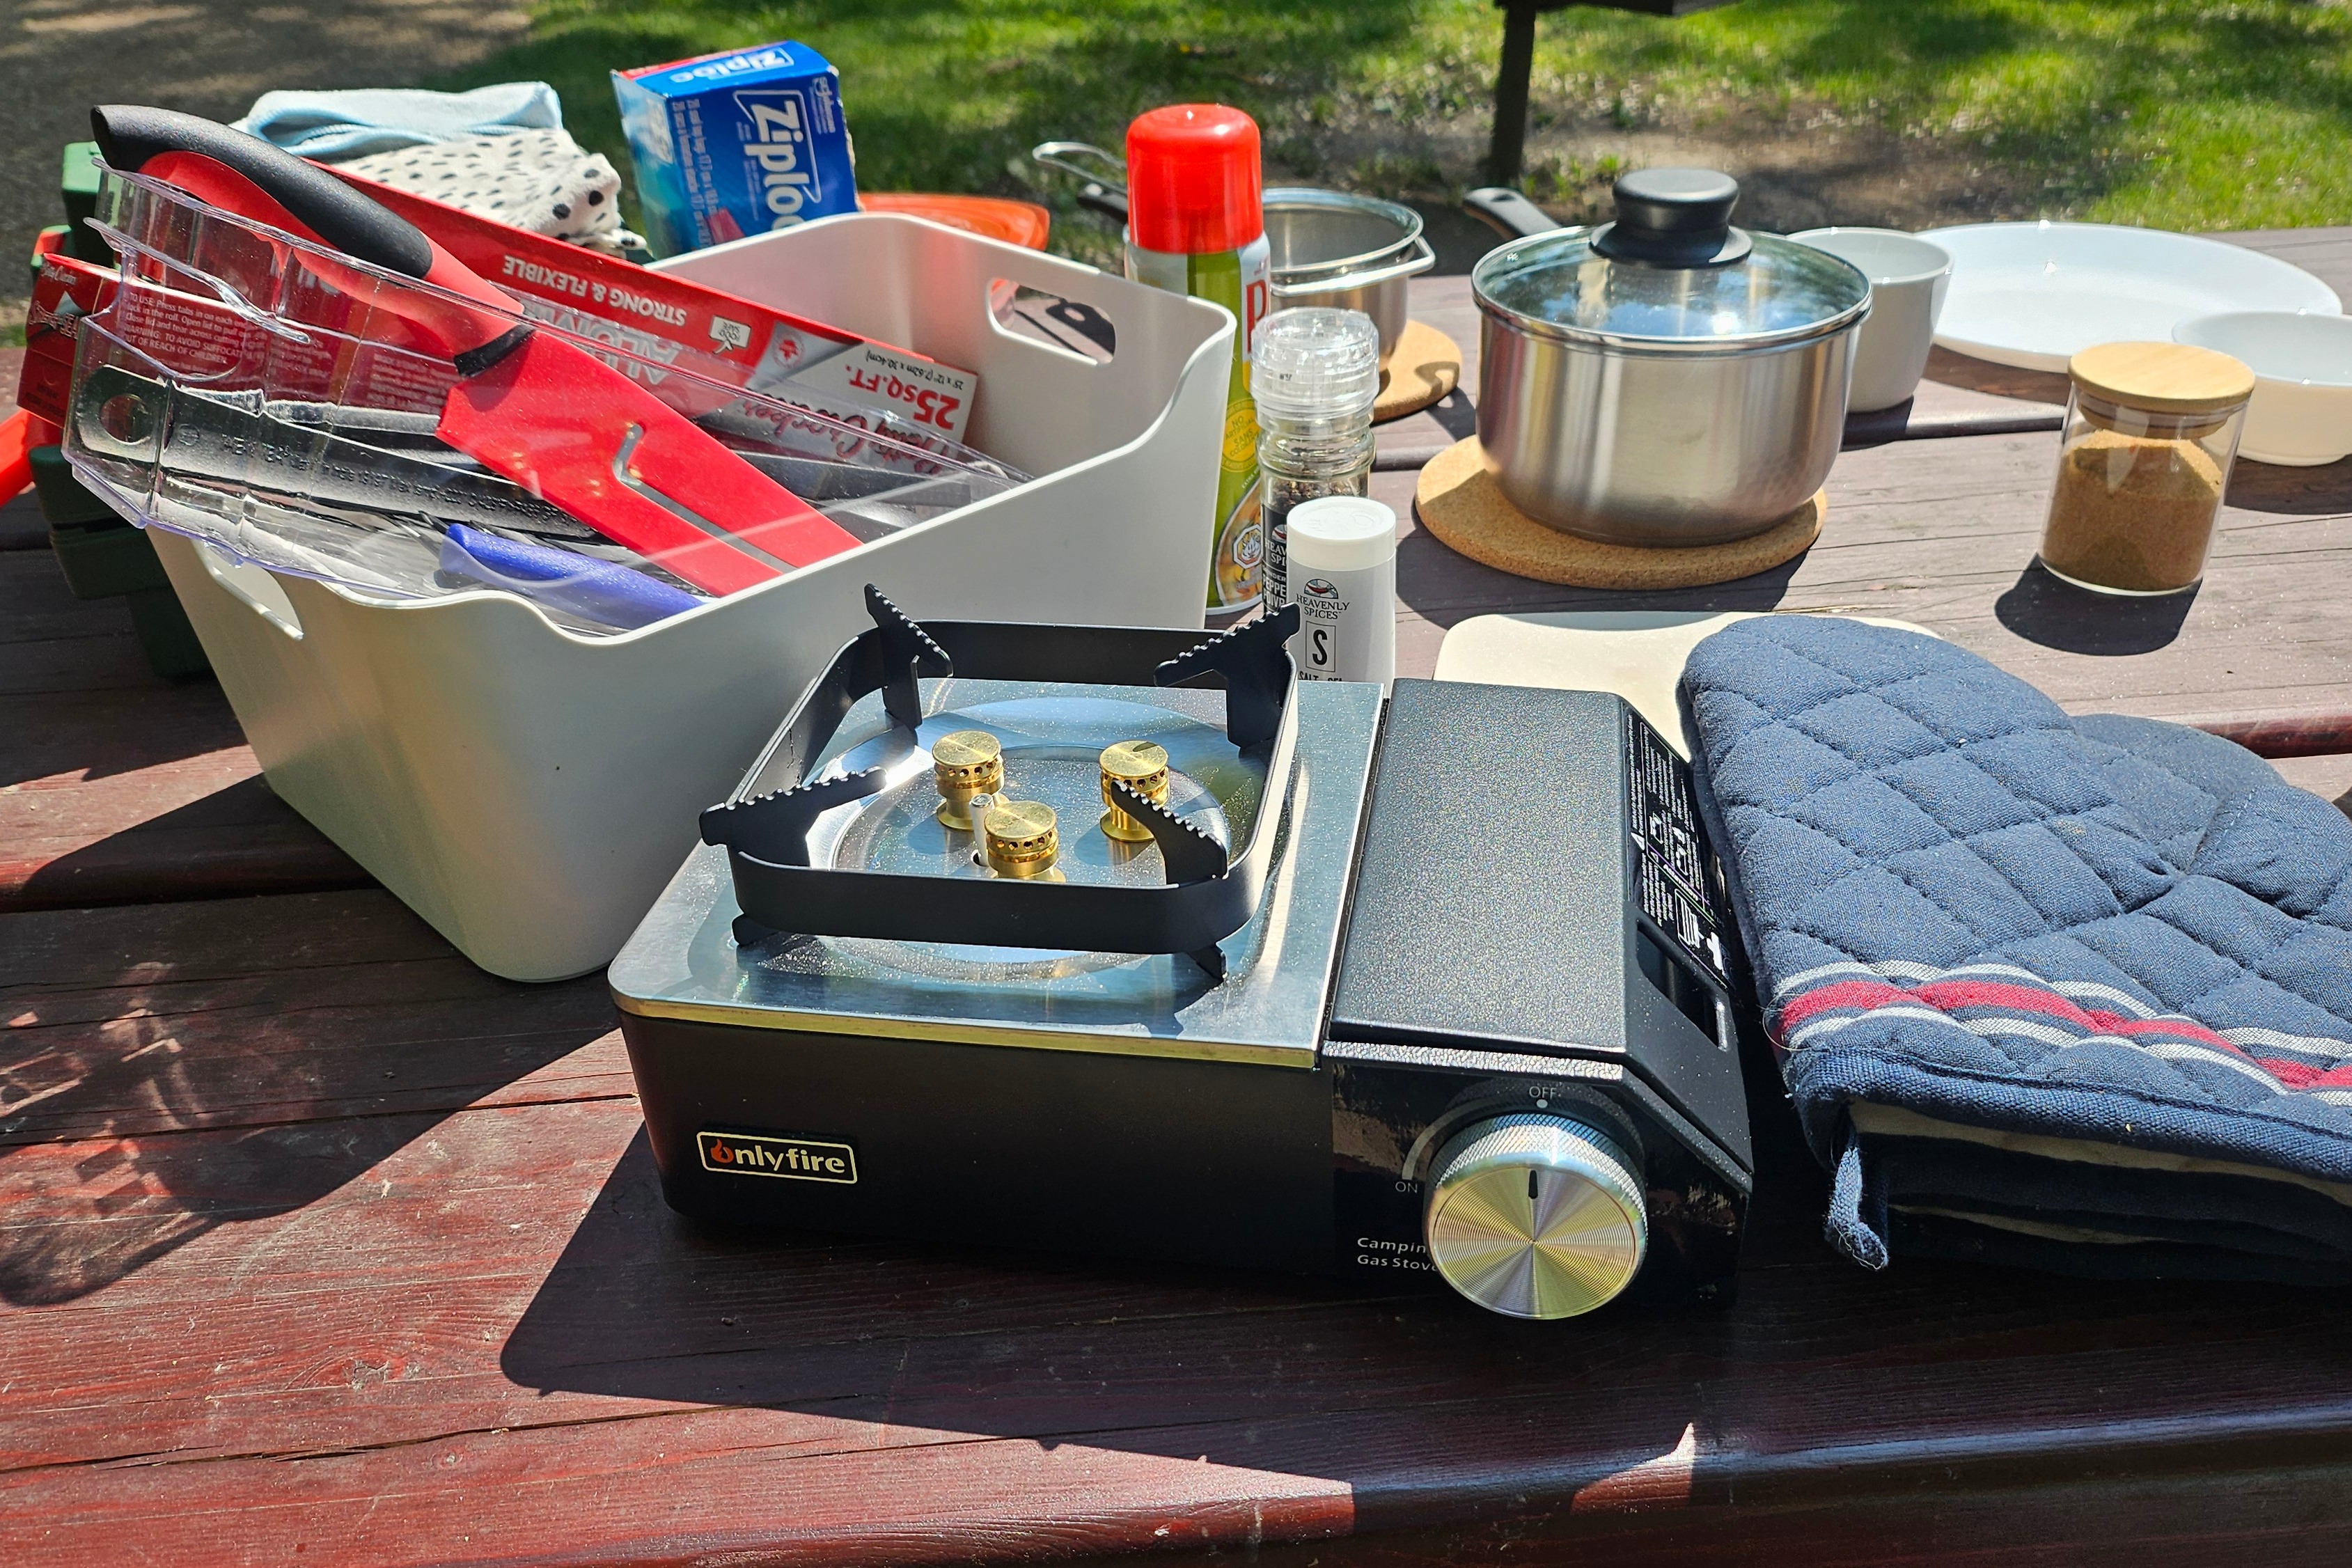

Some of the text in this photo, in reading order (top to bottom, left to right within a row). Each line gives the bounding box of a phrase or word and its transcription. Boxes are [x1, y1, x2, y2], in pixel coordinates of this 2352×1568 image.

[502, 255, 687, 327] STRONG & FLEXIBLE
[151, 308, 164, 318] the
[182, 315, 201, 327] Open
[157, 299, 176, 312] Press
[178, 306, 194, 316] tabs
[196, 308, 203, 318] in
[204, 313, 214, 321] on
[215, 315, 233, 324] each
[156, 320, 171, 330] and
[173, 324, 187, 334] tear
[189, 329, 212, 340] across
[138, 337, 148, 346] OF
[149, 339, 174, 353] REACH
[178, 345, 188, 355] OF
[166, 333, 175, 343] TO
[176, 336, 201, 348] AVOID
[742, 393, 868, 460] Crocker
[1264, 537, 1287, 556] HEAV
[1271, 552, 1287, 567] SPI
[1262, 573, 1287, 597] PEPPE
[1296, 593, 1350, 611] HEAVENLY
[1312, 629, 1328, 666] S
[1529, 1086, 1559, 1099] OFF
[1395, 1181, 1418, 1193] ON
[1357, 1237, 1427, 1254] Campin
[1357, 1254, 1388, 1267] Gas
